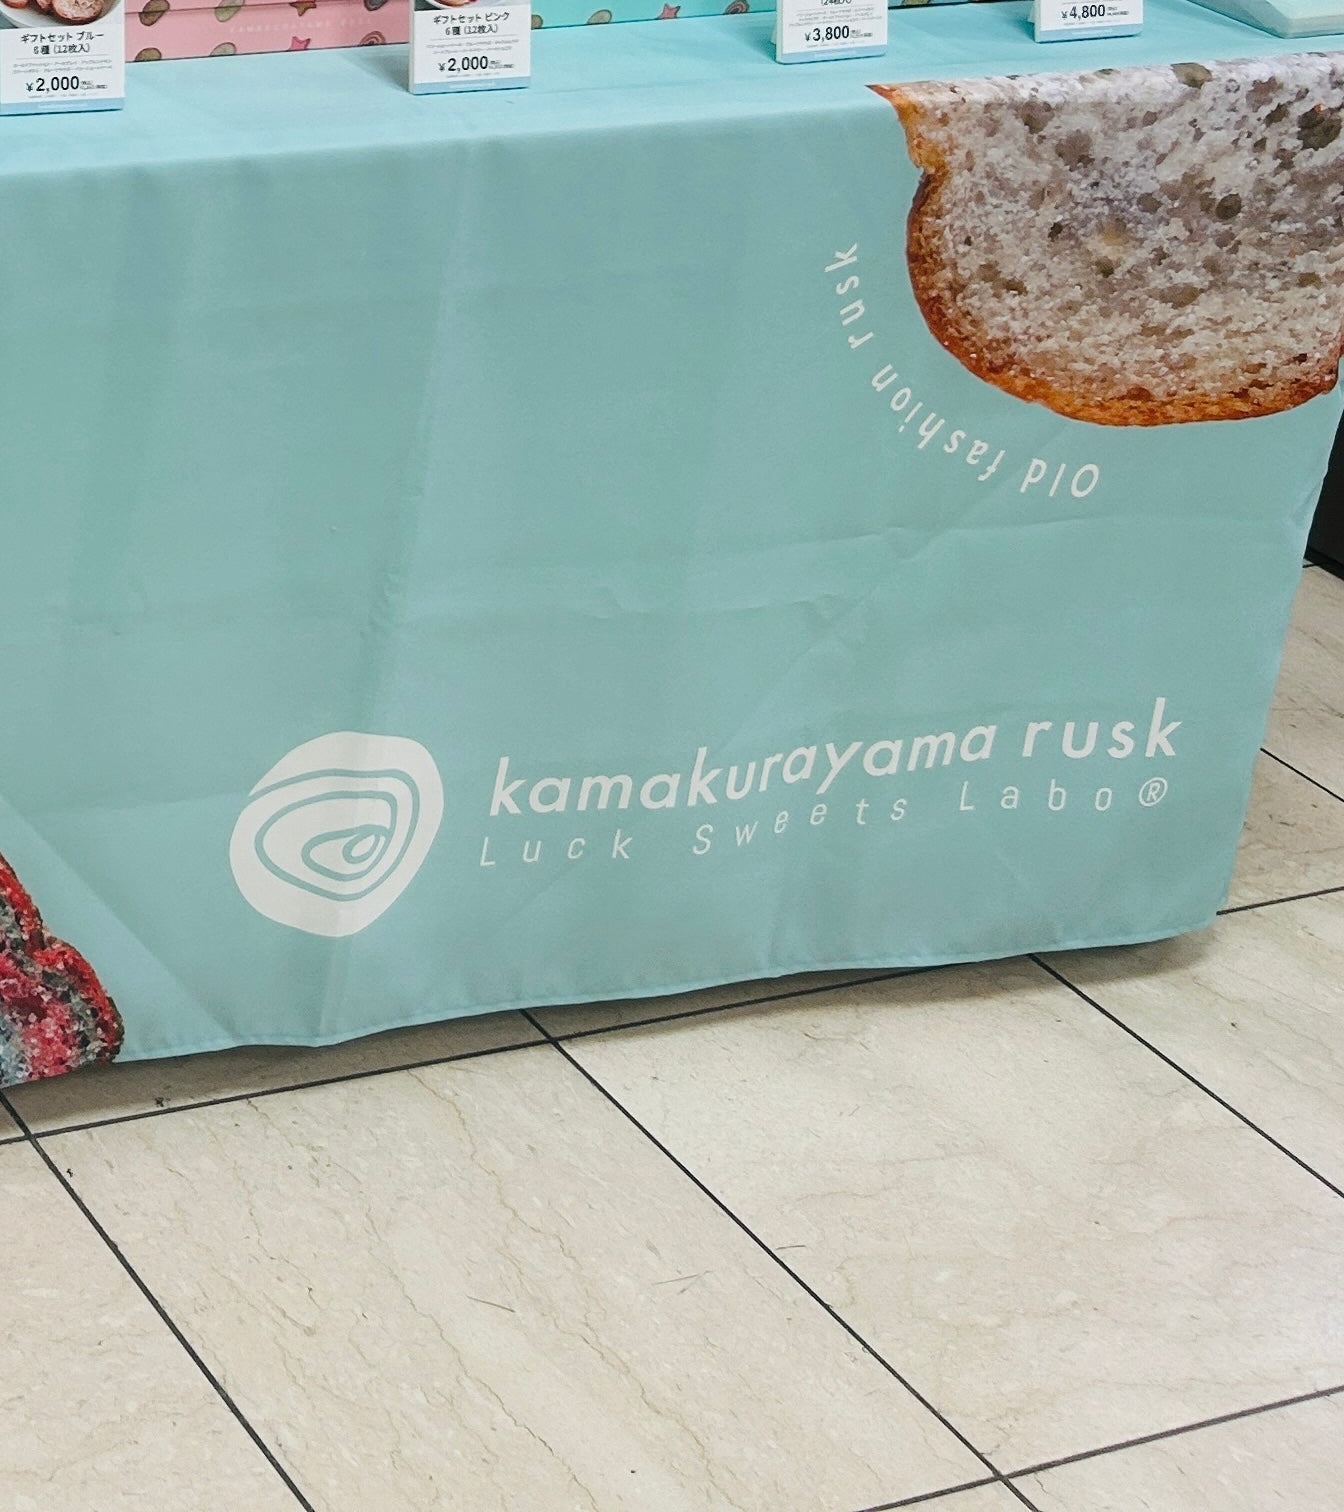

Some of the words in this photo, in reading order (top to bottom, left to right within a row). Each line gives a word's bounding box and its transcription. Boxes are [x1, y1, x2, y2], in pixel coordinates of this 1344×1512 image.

[1062, 4, 1106, 22] ¥4,800
[21, 33, 73, 43] ギフトセット
[804, 25, 850, 43] ¥3,800
[438, 55, 489, 73] ¥2,000
[25, 75, 80, 93] ¥2,000
[823, 242, 875, 350] rusk
[870, 364, 1006, 482] fashion
[1019, 458, 1100, 498] Old
[488, 720, 993, 819] kamakurayama
[1023, 696, 1182, 761] rusk
[478, 827, 633, 868] Luck
[692, 795, 908, 857] Sweets
